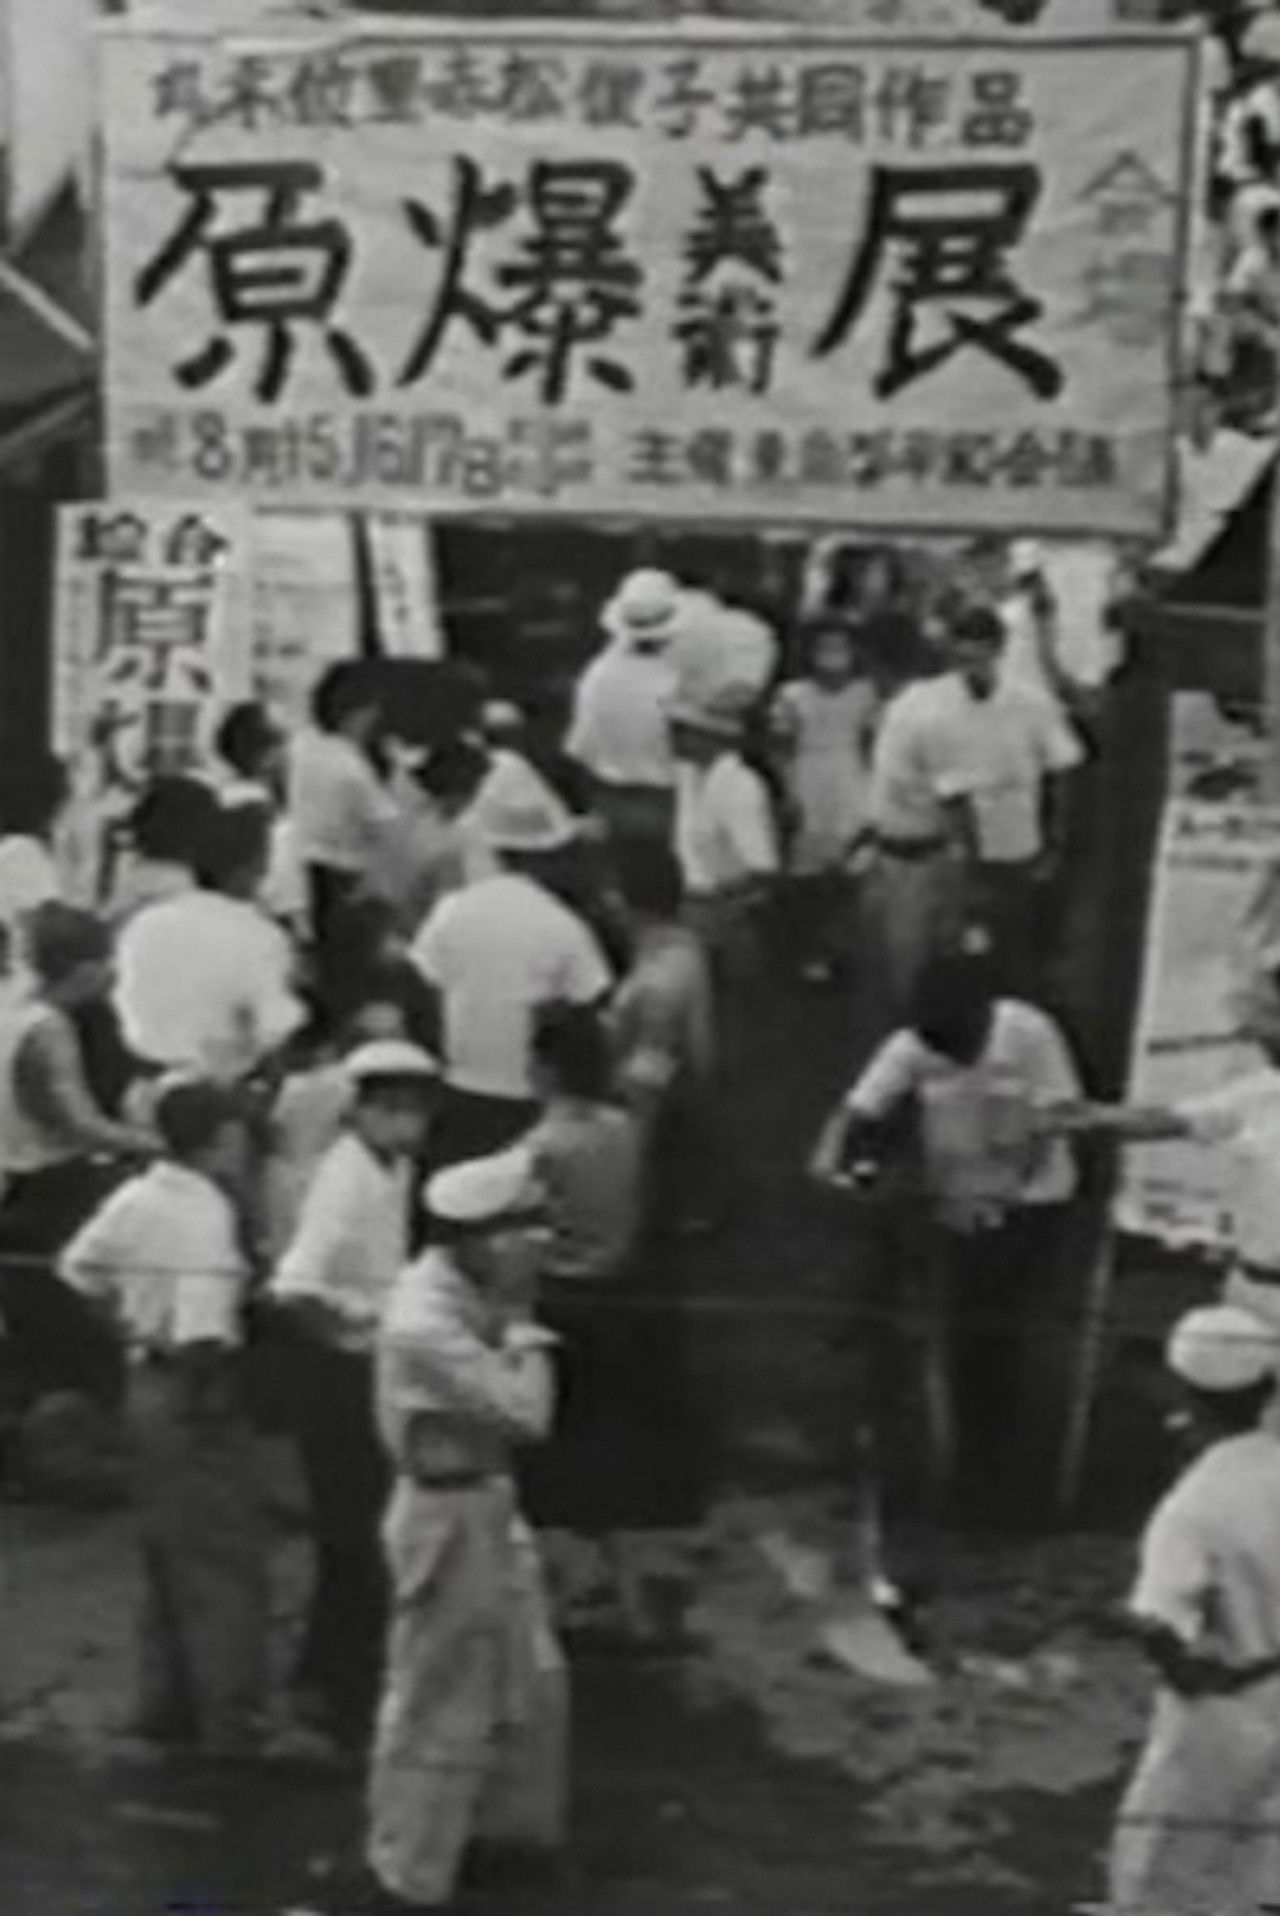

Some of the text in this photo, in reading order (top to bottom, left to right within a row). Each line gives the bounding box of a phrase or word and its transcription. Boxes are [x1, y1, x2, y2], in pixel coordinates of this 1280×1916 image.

[134, 150, 1063, 404] 原爆美術展
